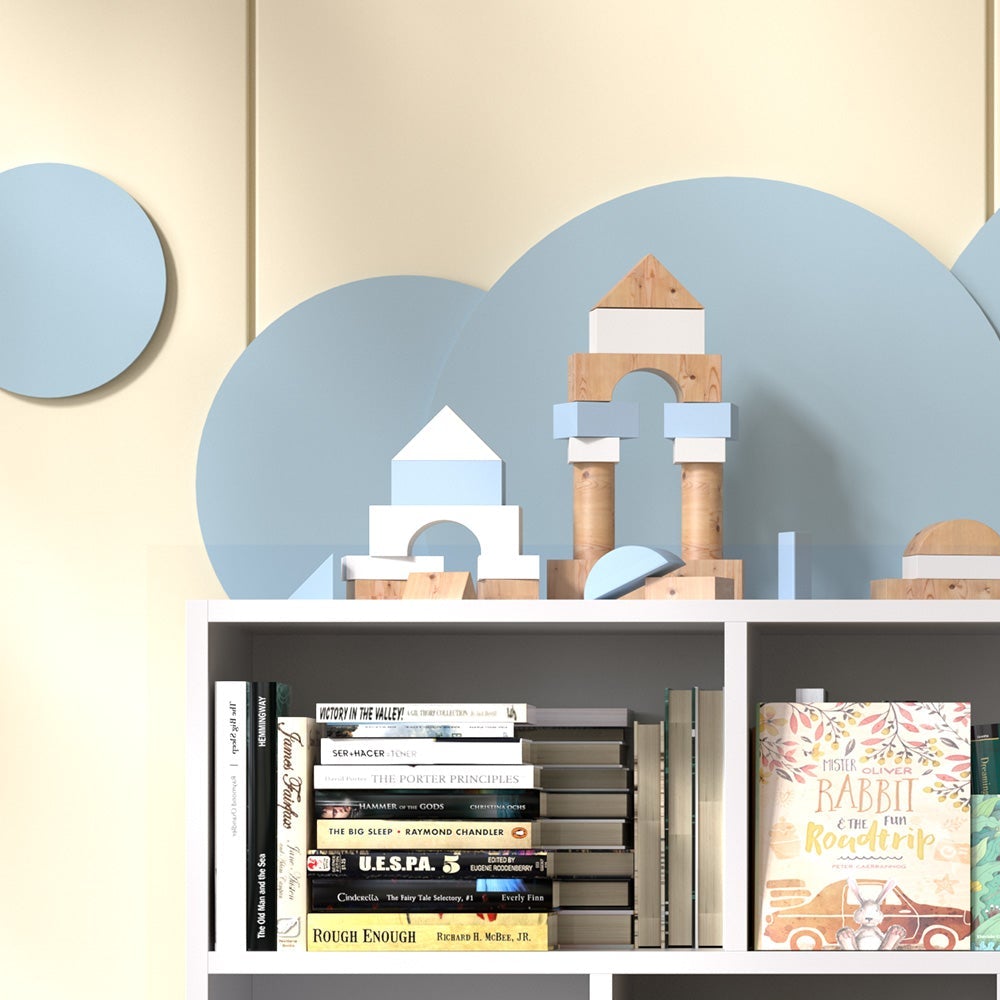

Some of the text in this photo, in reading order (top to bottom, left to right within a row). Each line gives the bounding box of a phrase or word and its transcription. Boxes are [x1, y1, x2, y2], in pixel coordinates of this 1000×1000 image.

[320, 707, 404, 721] VICTORY IN THE VALLEY!
[258, 696, 266, 747] HEMMINGWAY
[823, 759, 856, 772] MISTER
[277, 722, 304, 829] James Fairfax
[371, 774, 520, 783] THE PORTER PRINCIPLES
[815, 774, 919, 814] RABBIT
[848, 819, 868, 829] THE
[805, 820, 935, 860] Roadtrip
[257, 853, 265, 867] Sea
[359, 856, 435, 871] U.E.S.P.A.
[442, 855, 461, 873] 5
[337, 892, 379, 902] Cinderella
[400, 894, 416, 903] Fairy
[502, 894, 524, 903] Everly
[257, 912, 265, 925] Old
[257, 926, 265, 939] The
[313, 929, 417, 943] ROUGH ENOUGH
[473, 932, 481, 942] H.
